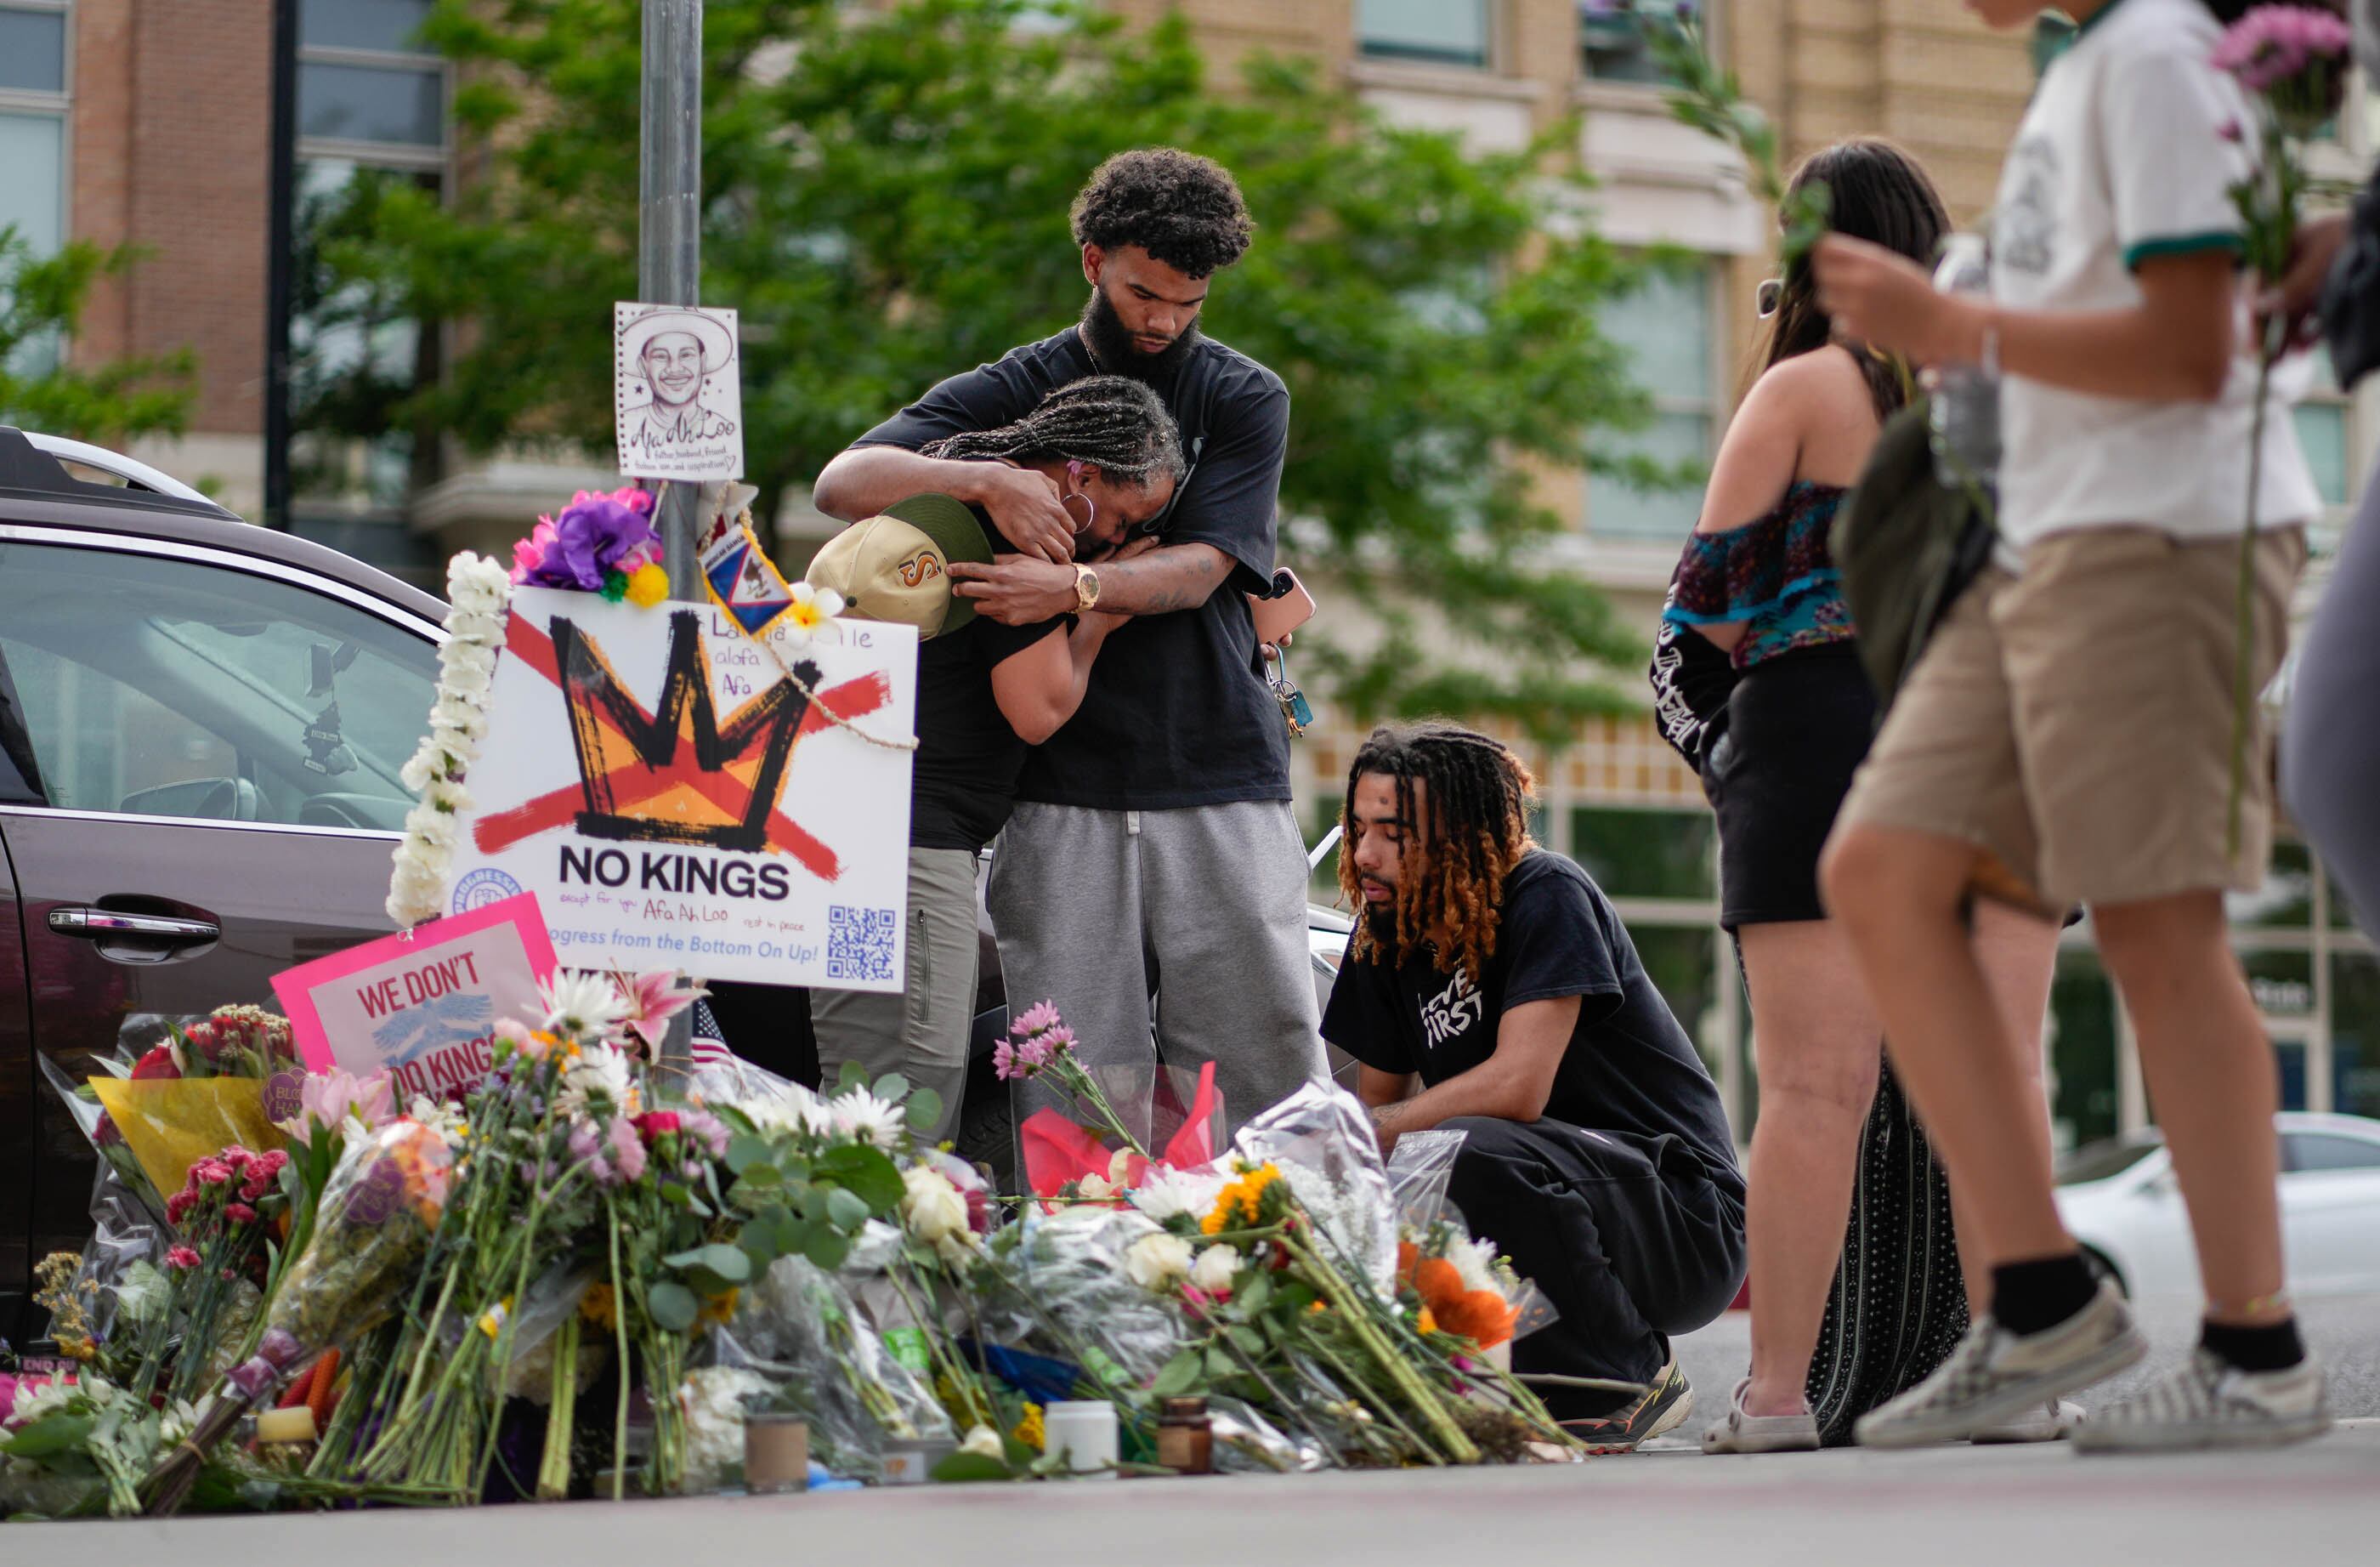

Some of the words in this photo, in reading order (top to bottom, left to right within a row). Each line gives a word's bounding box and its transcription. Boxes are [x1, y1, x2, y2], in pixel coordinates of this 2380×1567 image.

[631, 416, 663, 459] Afa
[666, 411, 695, 443] Ah
[695, 410, 735, 440] Loo
[898, 551, 942, 588] S
[715, 646, 761, 667] alofa
[722, 673, 752, 695] Afa
[559, 844, 631, 889] NO
[640, 851, 790, 901] KINGS
[643, 898, 674, 922] Afa
[678, 903, 700, 923] Ah
[702, 904, 728, 923] Loo
[779, 919, 806, 934] peace
[548, 928, 607, 945] ogress
[611, 928, 651, 948] from
[656, 932, 684, 951] the
[689, 935, 752, 957] Bottom
[757, 940, 783, 959] On
[788, 943, 819, 966] Up!
[355, 976, 406, 1019] WE
[402, 951, 479, 1005] DON'T
